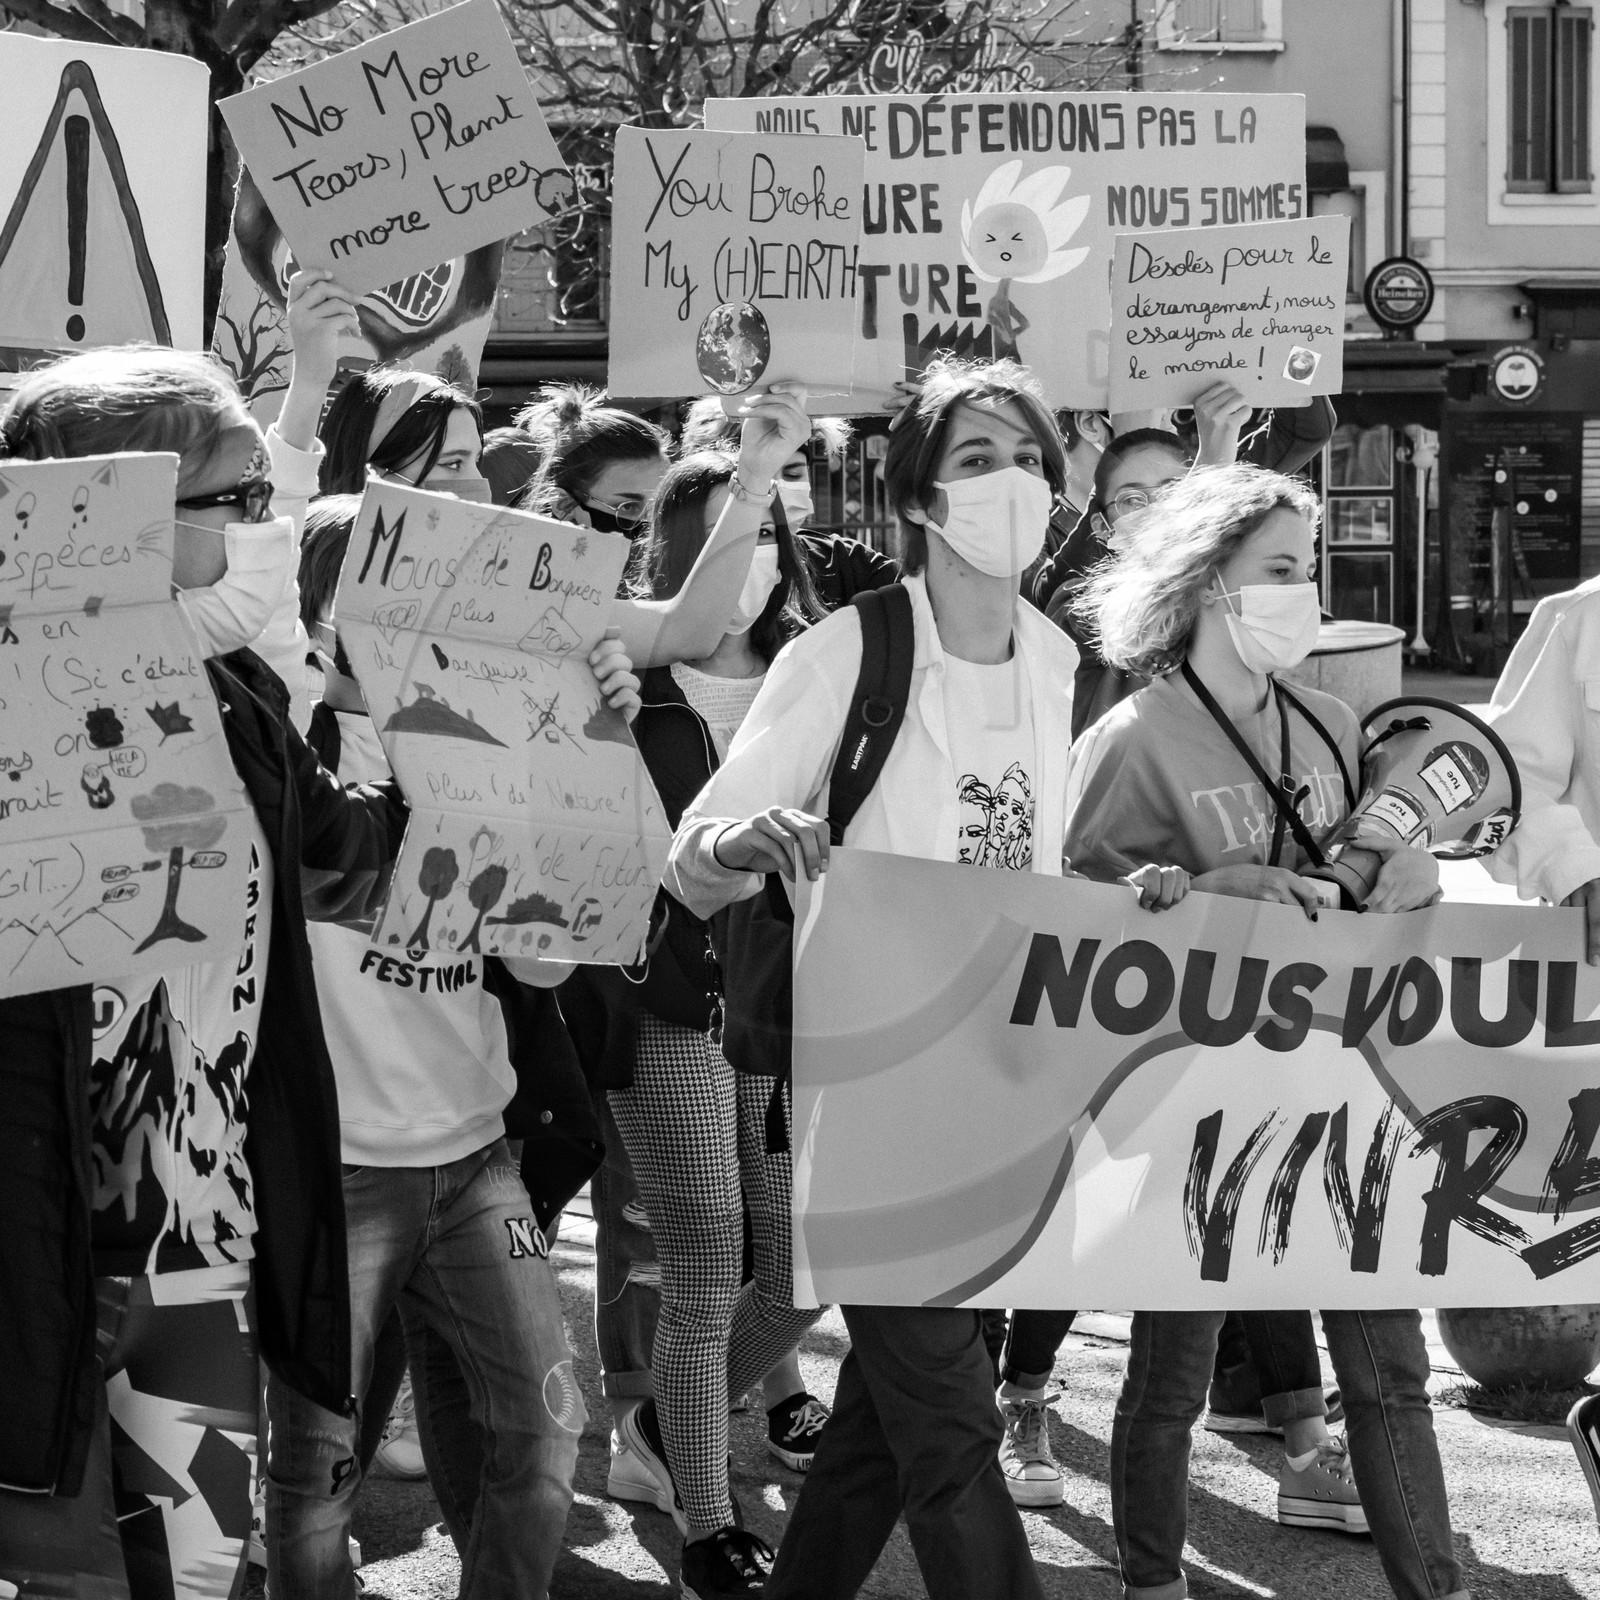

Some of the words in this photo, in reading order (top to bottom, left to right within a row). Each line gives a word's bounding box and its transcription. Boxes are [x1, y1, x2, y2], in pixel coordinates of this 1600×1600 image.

[271, 85, 348, 149] No
[361, 50, 491, 115] More
[842, 105, 877, 152] NE
[888, 95, 1124, 159] DÉFENDONS
[1137, 106, 1196, 149] PAS
[1215, 107, 1257, 144] LA
[273, 149, 408, 207] Tears,
[410, 95, 523, 159] Plant
[645, 137, 733, 233] You
[749, 153, 851, 223] Broke
[1107, 185, 1190, 227] NOUS
[1200, 183, 1303, 226] SOMMES
[330, 209, 430, 259] more
[433, 160, 543, 216] trees
[644, 240, 699, 321] My
[714, 236, 859, 303] (H)EARTH
[1128, 242, 1213, 283] Désolés
[1221, 246, 1294, 285] pour
[1310, 236, 1333, 265] le
[1284, 296, 1336, 310] nous
[1126, 322, 1226, 351] essayons
[1232, 322, 1254, 339] de
[1262, 319, 1334, 343] changer
[1128, 355, 1150, 379] le
[1164, 358, 1248, 375] monde
[358, 505, 457, 592] Moins
[482, 540, 512, 586] de
[43, 621, 80, 639] en
[374, 641, 403, 670] de
[850, 733, 869, 771] EASTPAK
[508, 783, 528, 805] de
[540, 837, 570, 882] de
[360, 949, 478, 994] FESTIVAL
[1009, 932, 1328, 1052] NOUS
[1342, 955, 1600, 1048] VOUL
